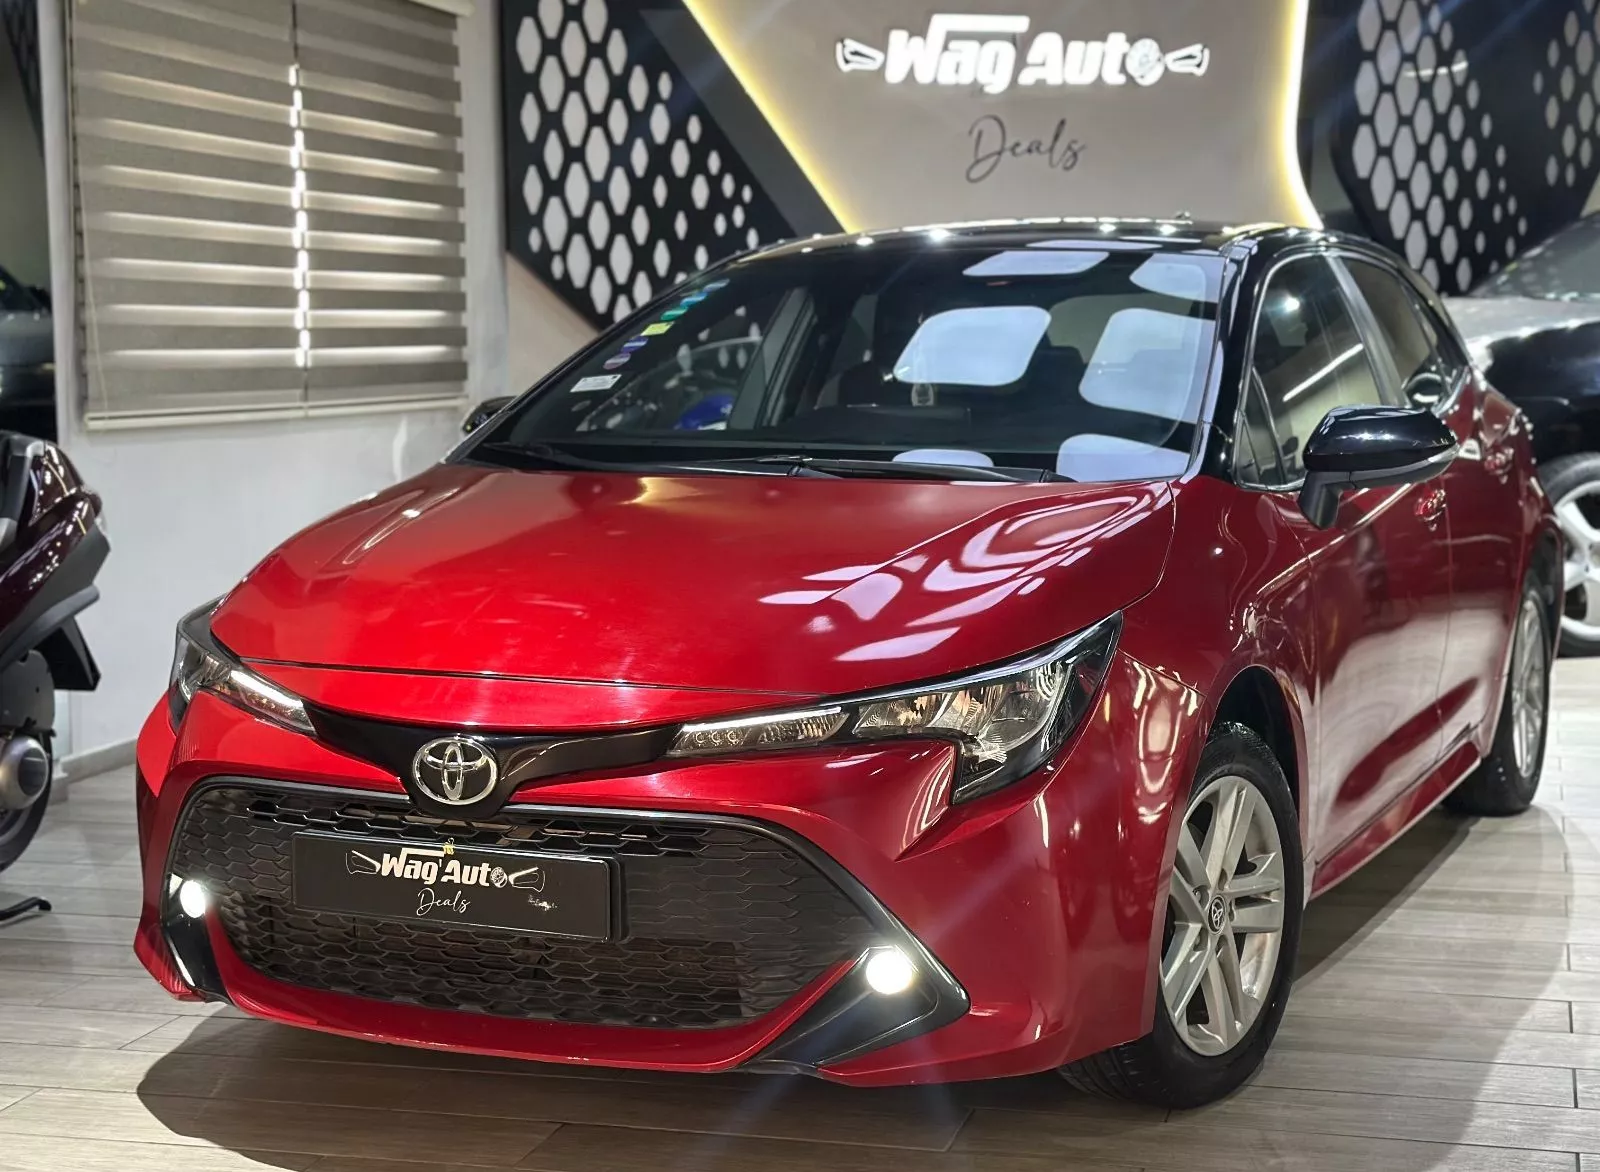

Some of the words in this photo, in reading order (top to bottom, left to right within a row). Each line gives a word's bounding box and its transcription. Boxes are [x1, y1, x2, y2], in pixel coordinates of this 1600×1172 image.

[885, 14, 1030, 94] Wag
[965, 114, 1087, 183] Deals
[416, 887, 470, 916] Deals
